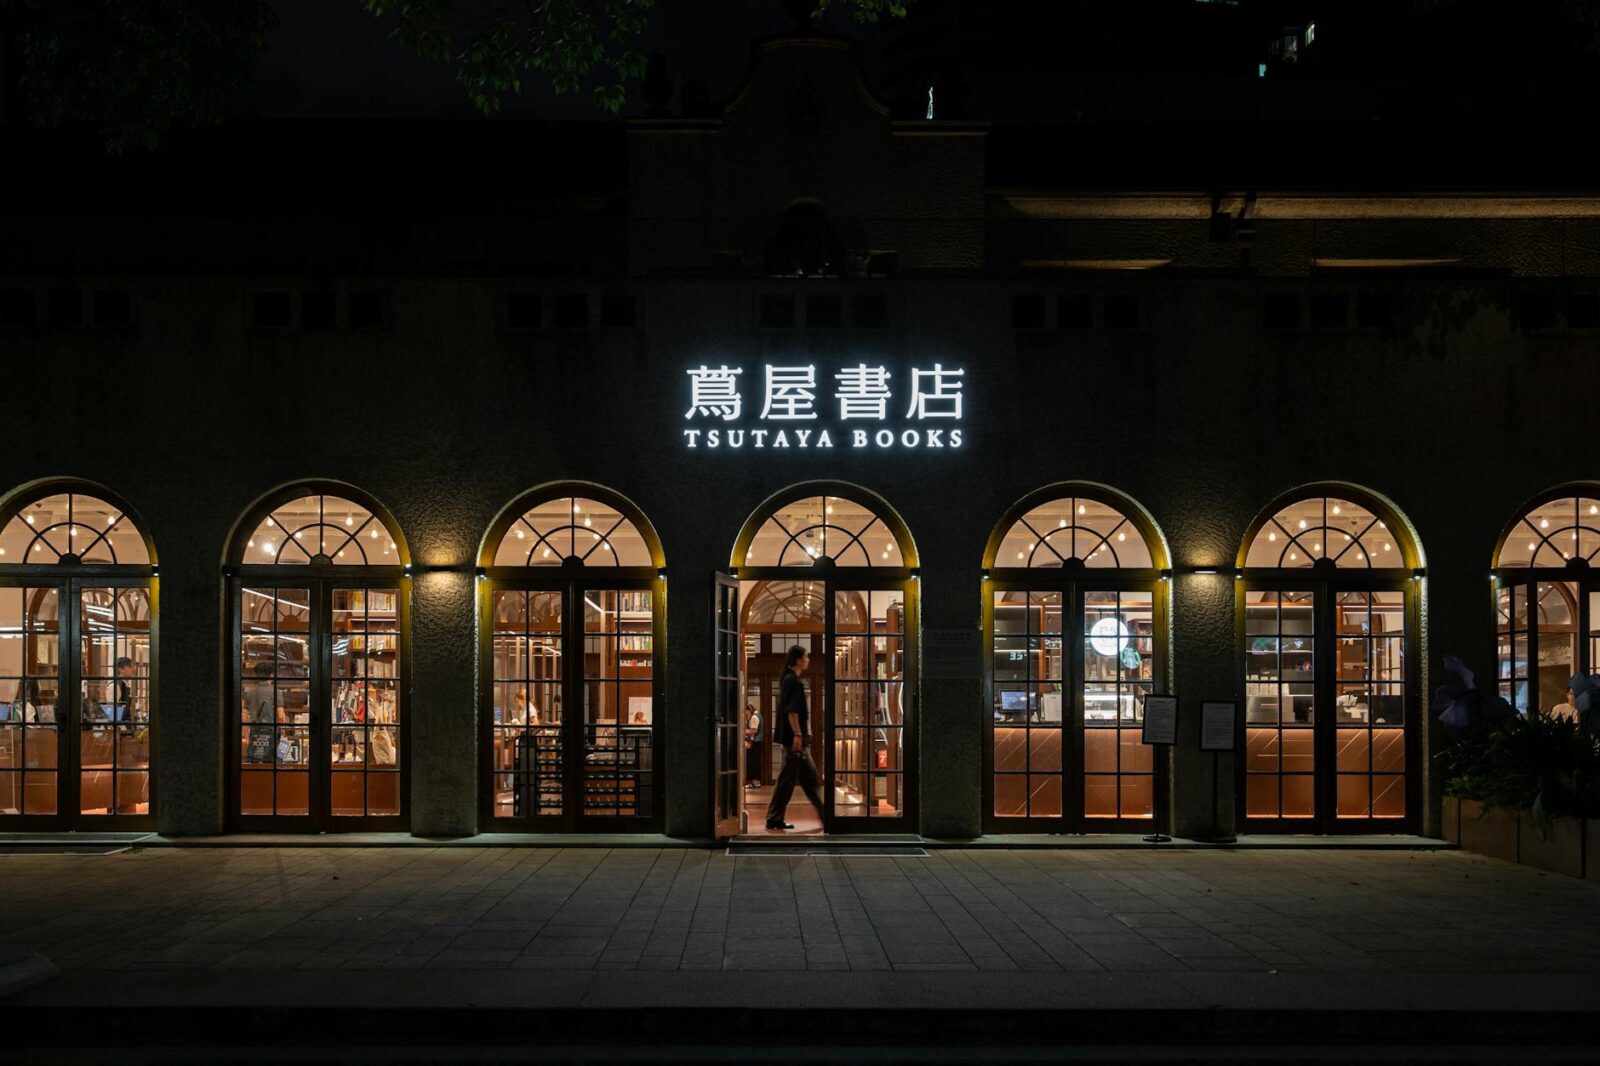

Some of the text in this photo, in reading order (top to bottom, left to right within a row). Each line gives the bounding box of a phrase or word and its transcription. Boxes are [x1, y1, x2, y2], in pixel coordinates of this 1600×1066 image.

[685, 363, 965, 421] 蔦屋書店
[683, 429, 963, 448] TSUTAYA BOOKS
